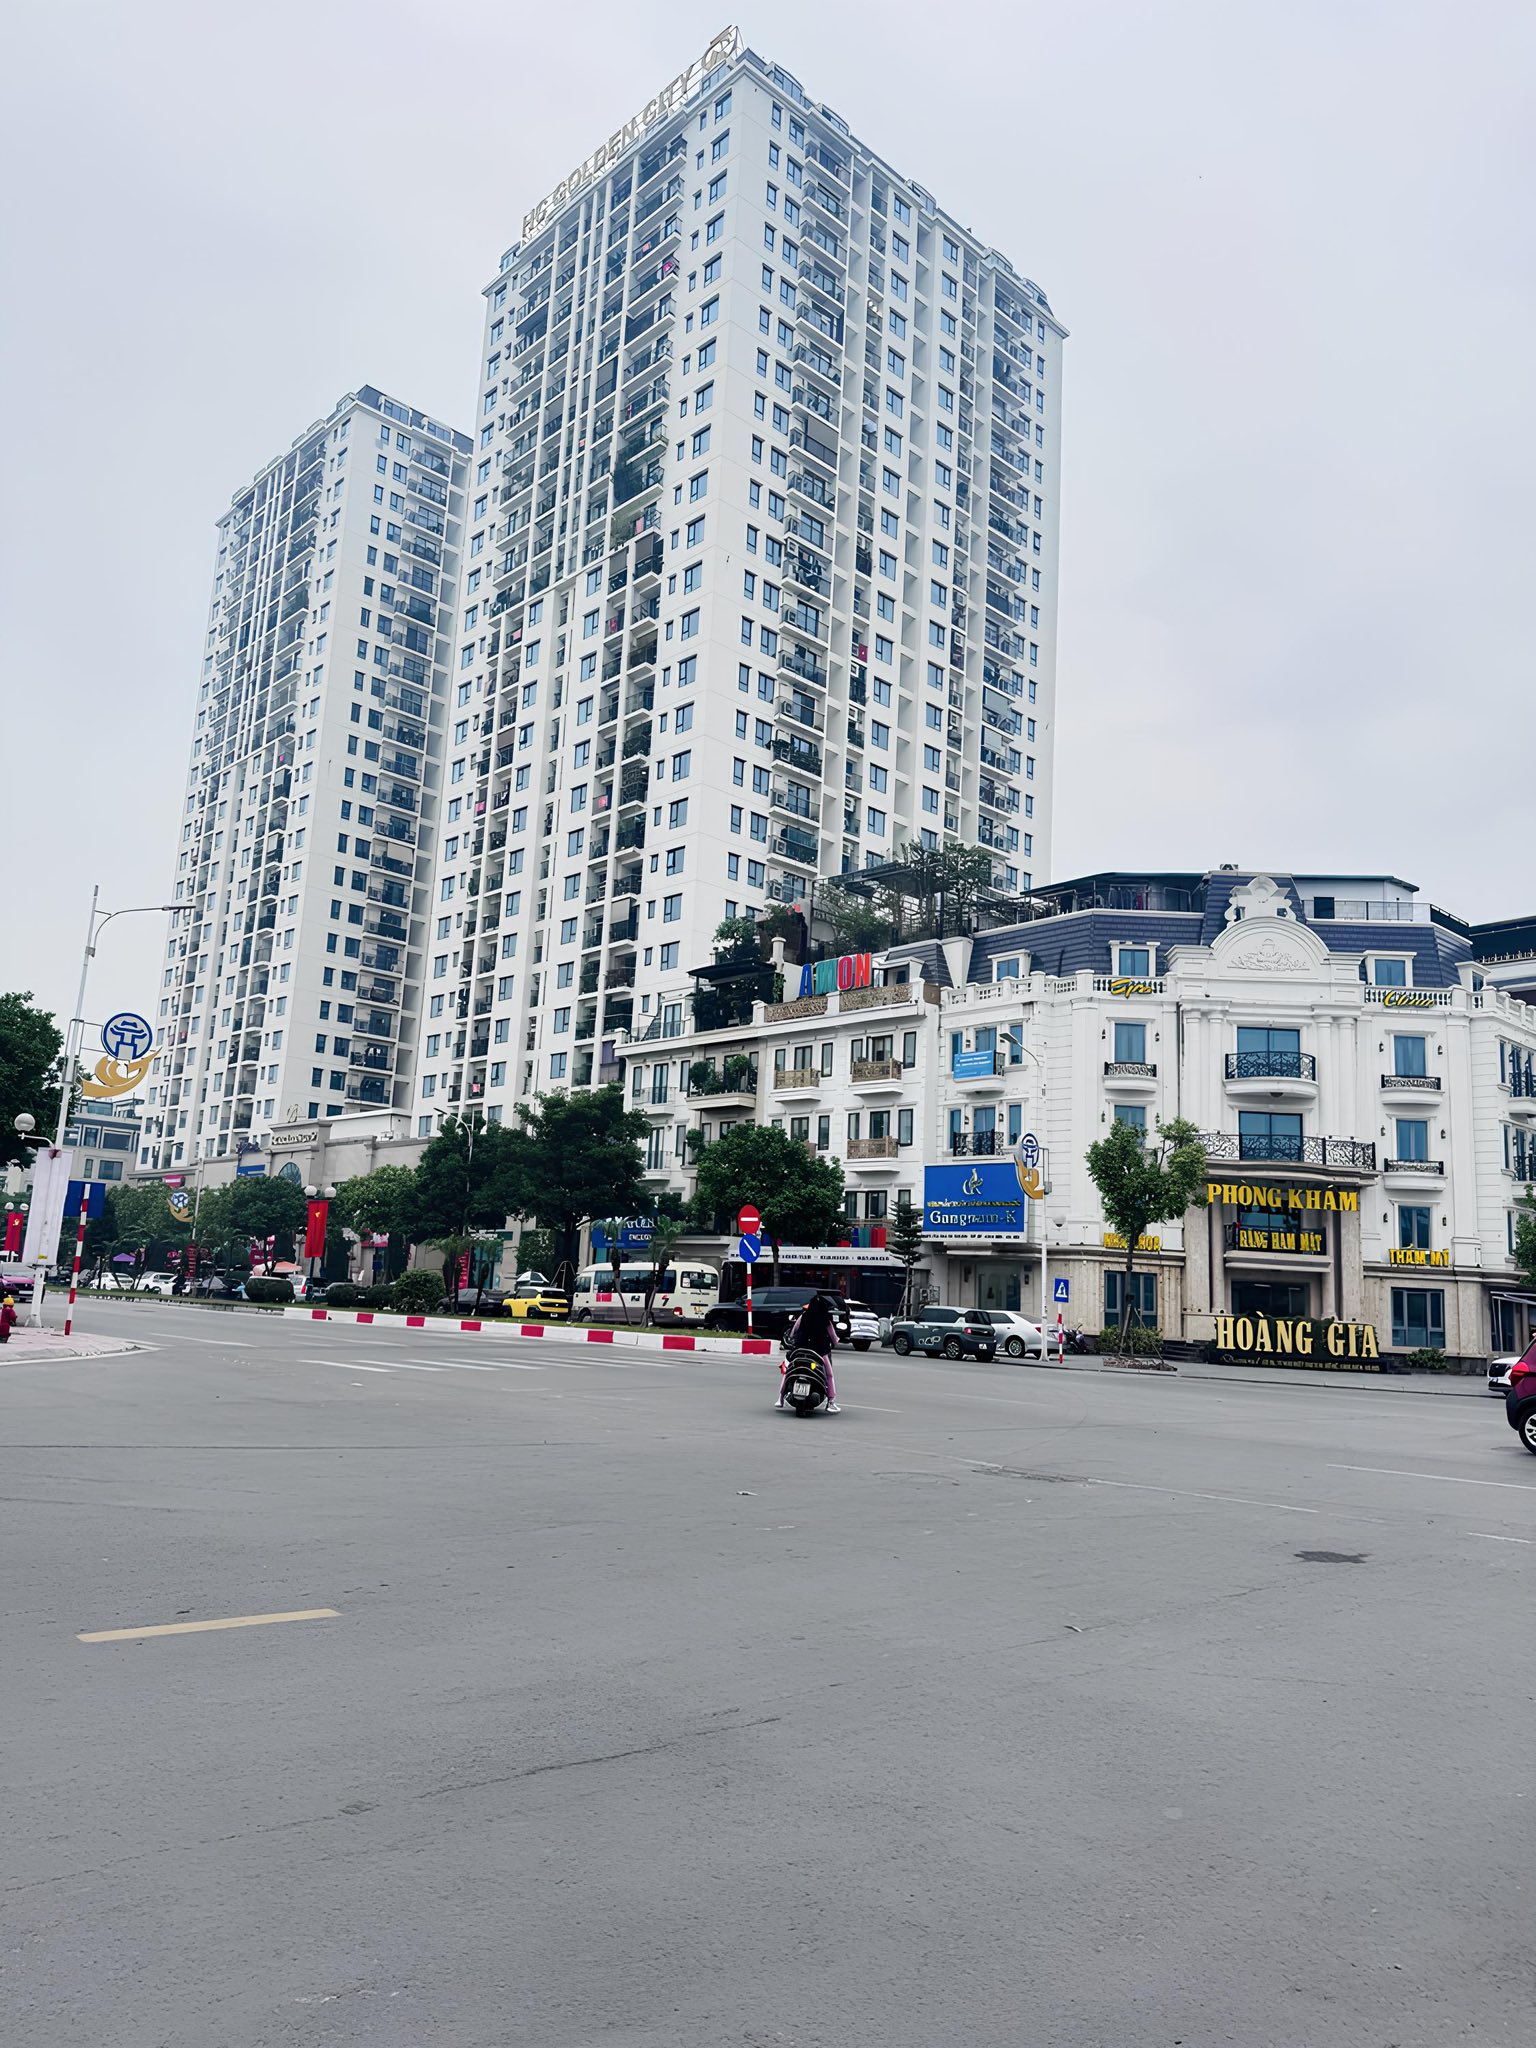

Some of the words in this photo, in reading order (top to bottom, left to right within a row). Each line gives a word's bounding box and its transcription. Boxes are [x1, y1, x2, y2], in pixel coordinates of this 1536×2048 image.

[552, 117, 641, 206] GOLDEN
[642, 64, 694, 126] CITY
[1207, 1179, 1282, 1208] PHÒNG
[1288, 1184, 1358, 1212] KHÁM
[1216, 1310, 1314, 1355] HOÀNG
[1327, 1322, 1380, 1358] GIA
